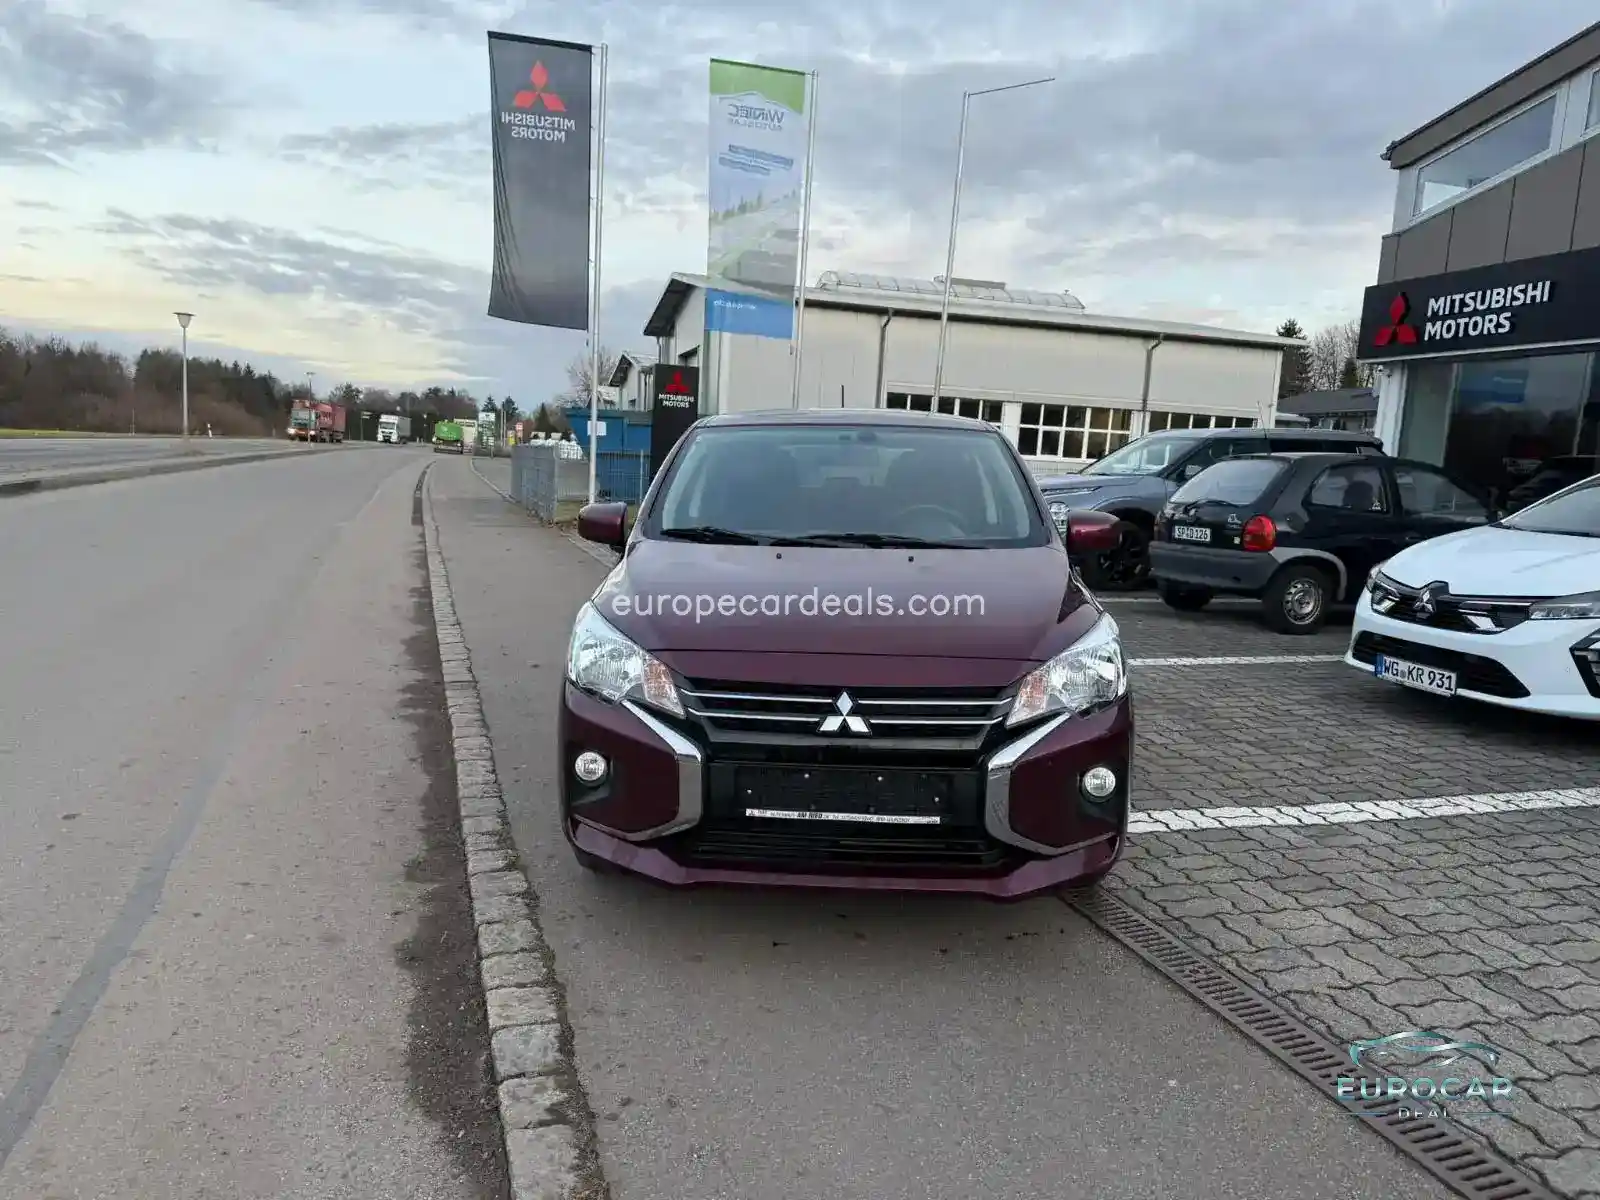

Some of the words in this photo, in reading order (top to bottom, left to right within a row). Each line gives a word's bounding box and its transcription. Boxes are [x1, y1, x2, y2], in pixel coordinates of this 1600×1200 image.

[1426, 280, 1551, 318] MITSUBISHI
[1423, 311, 1512, 341] MOTORS
[658, 393, 695, 402] MITSUBISHI
[662, 400, 690, 408] MOTORS
[1383, 658, 1399, 677] WG
[1407, 665, 1424, 684] KR
[1427, 671, 1454, 692] 931
